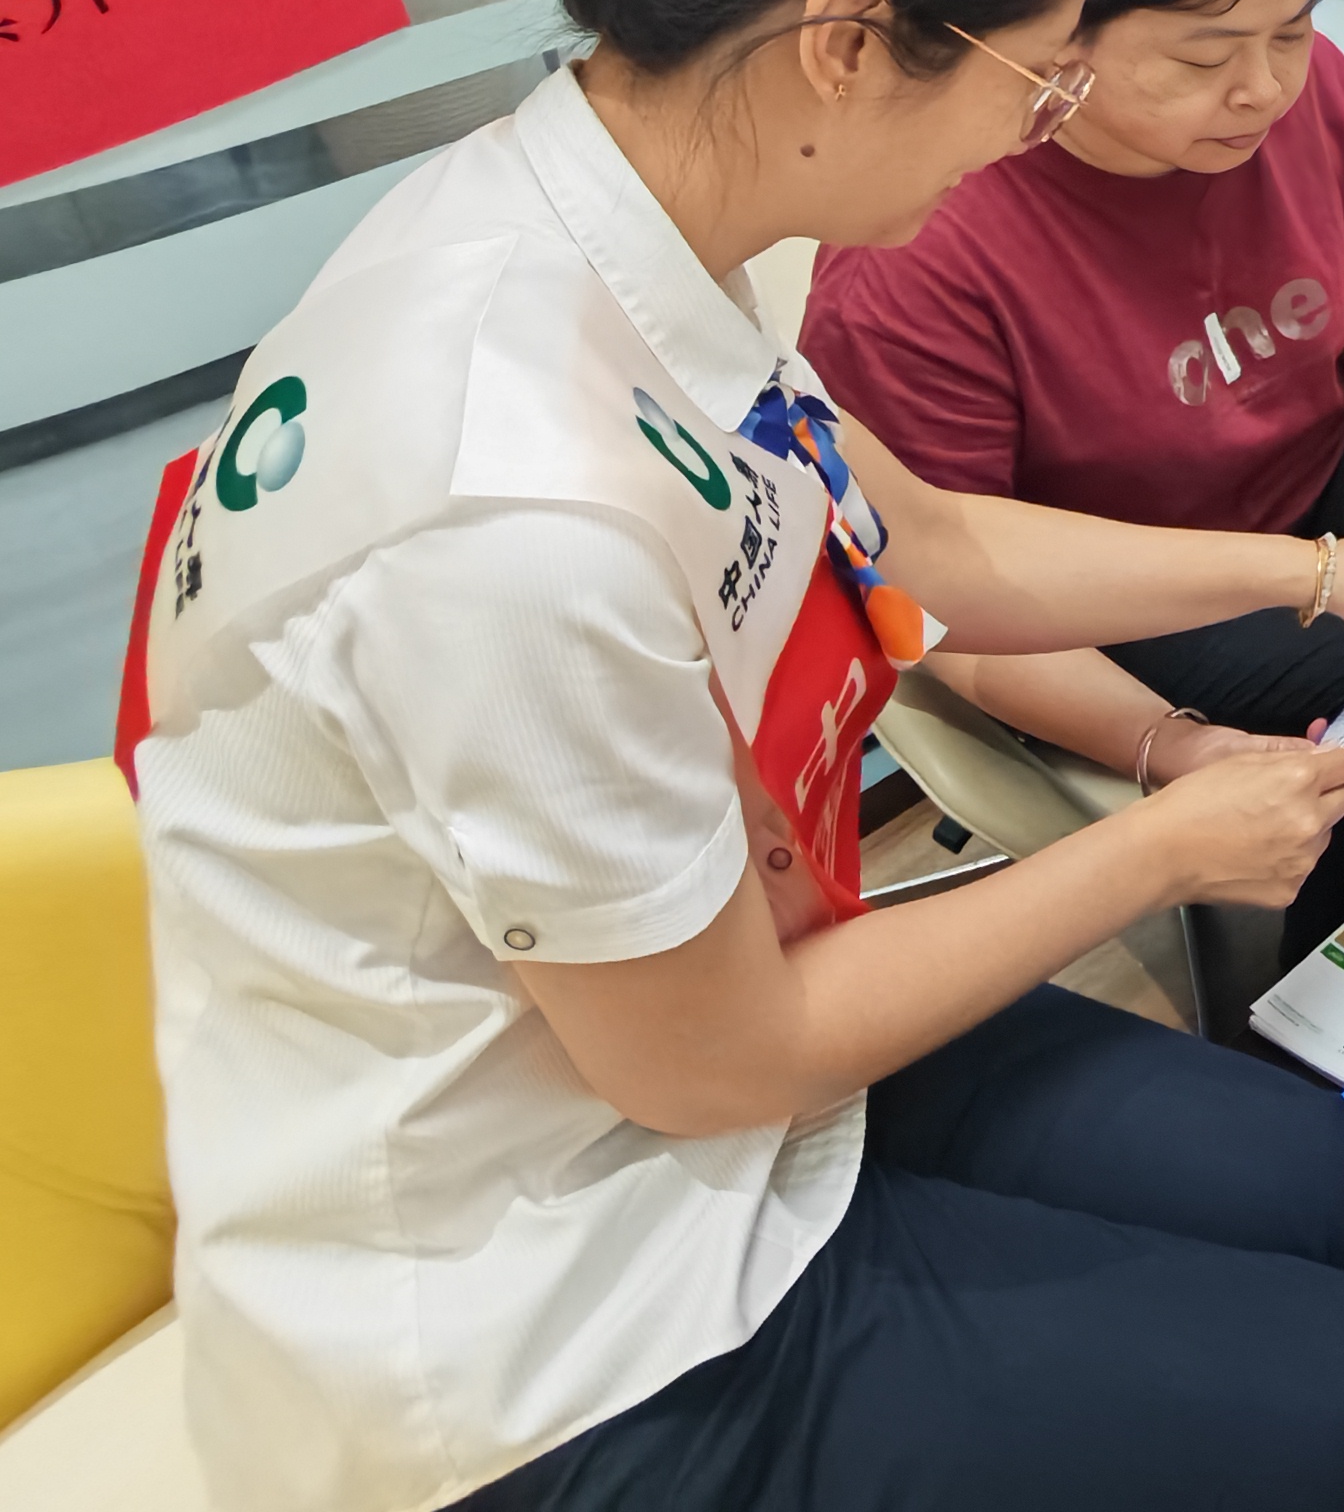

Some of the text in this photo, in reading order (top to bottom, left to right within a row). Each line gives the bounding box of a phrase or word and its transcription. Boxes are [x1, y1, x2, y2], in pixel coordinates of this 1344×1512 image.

[718, 451, 763, 610] 中国人寿
[732, 474, 781, 632] CHINA LIFE
